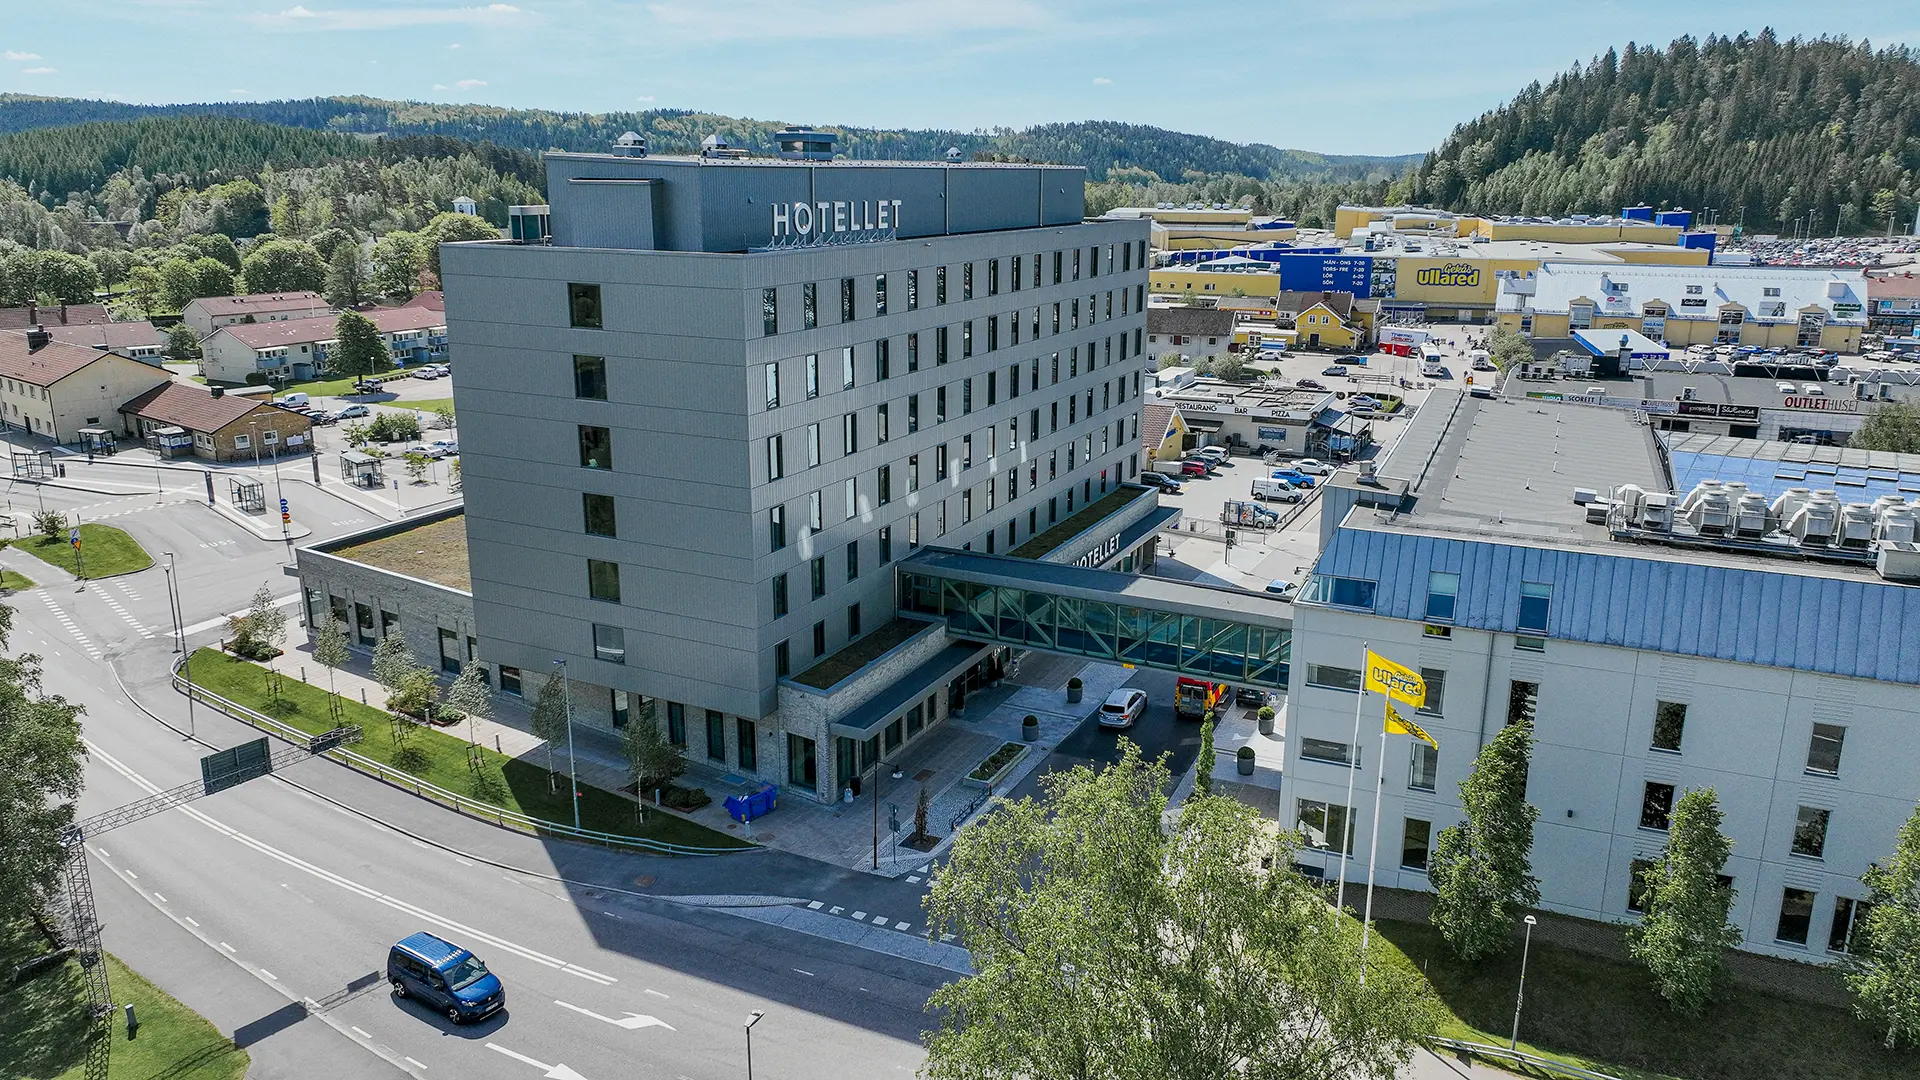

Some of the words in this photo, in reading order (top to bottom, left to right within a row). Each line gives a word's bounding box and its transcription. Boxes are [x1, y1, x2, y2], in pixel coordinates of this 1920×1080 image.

[771, 200, 902, 237] HOTELLET
[1443, 262, 1472, 274] Gekås
[1418, 268, 1480, 287] Ullared
[1568, 395, 1595, 403] SCORETT
[1784, 396, 1859, 412] OUTLETHUSET
[1175, 402, 1218, 412] RESTAURANG
[1234, 407, 1248, 415] BAR
[1271, 410, 1290, 418] PIZZA
[332, 518, 365, 527] BUSS
[199, 539, 236, 548] BUSS
[1372, 666, 1423, 696] Ullared
